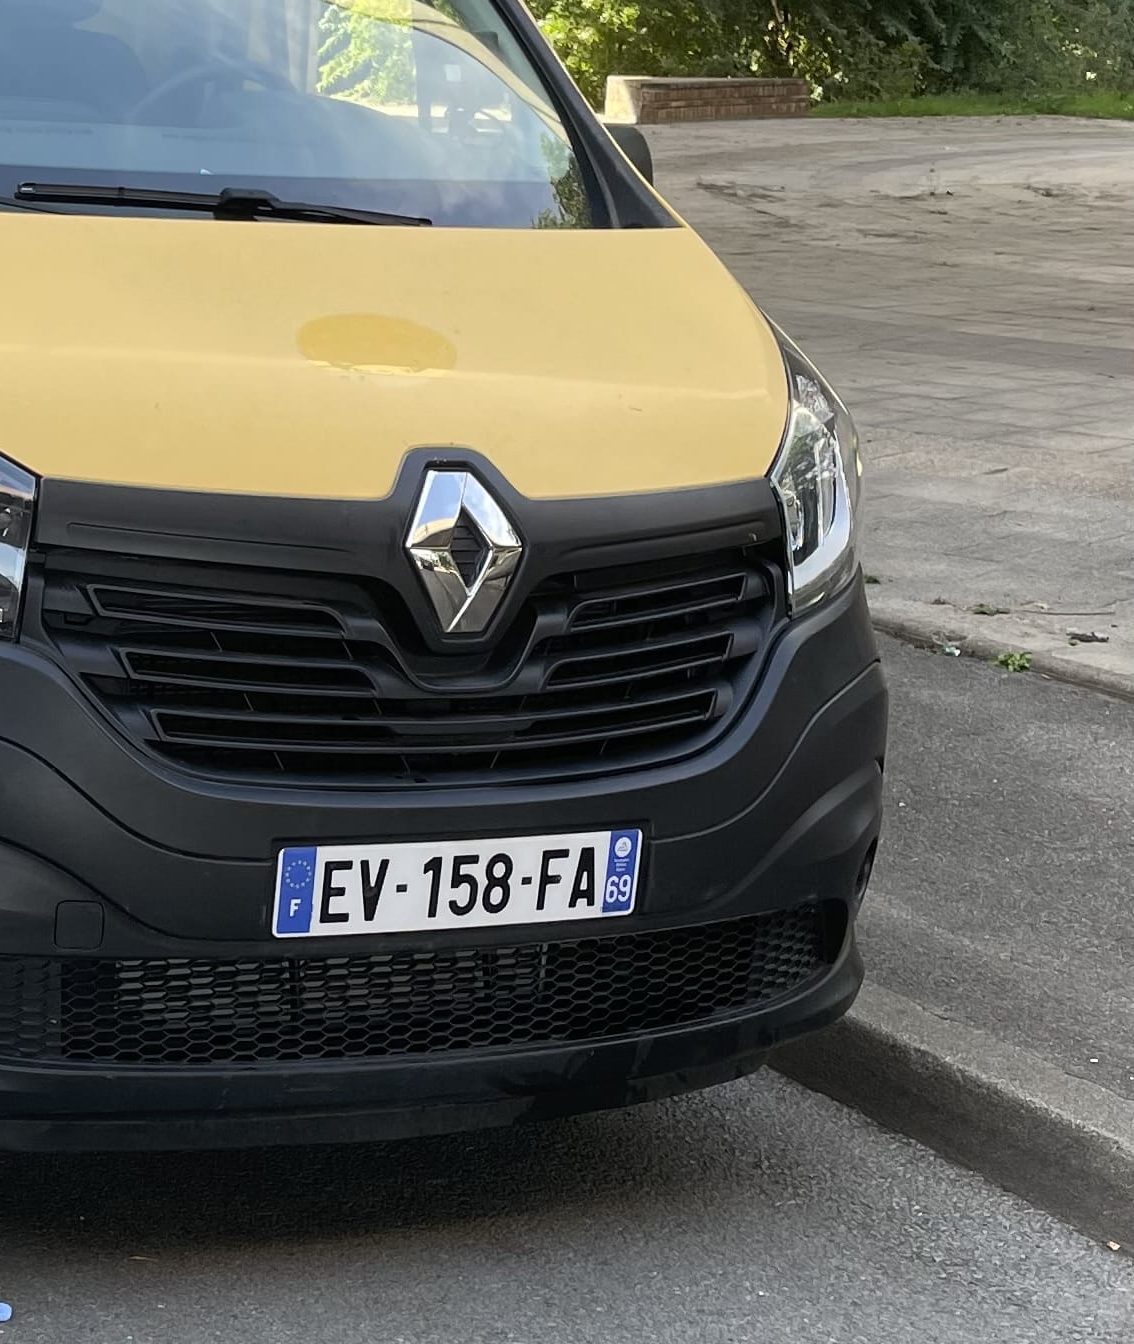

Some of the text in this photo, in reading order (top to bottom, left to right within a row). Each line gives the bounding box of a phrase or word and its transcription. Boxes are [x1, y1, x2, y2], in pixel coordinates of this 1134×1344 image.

[319, 846, 595, 924] EV-158-FA
[605, 874, 632, 904] 69
[289, 898, 302, 918] F
